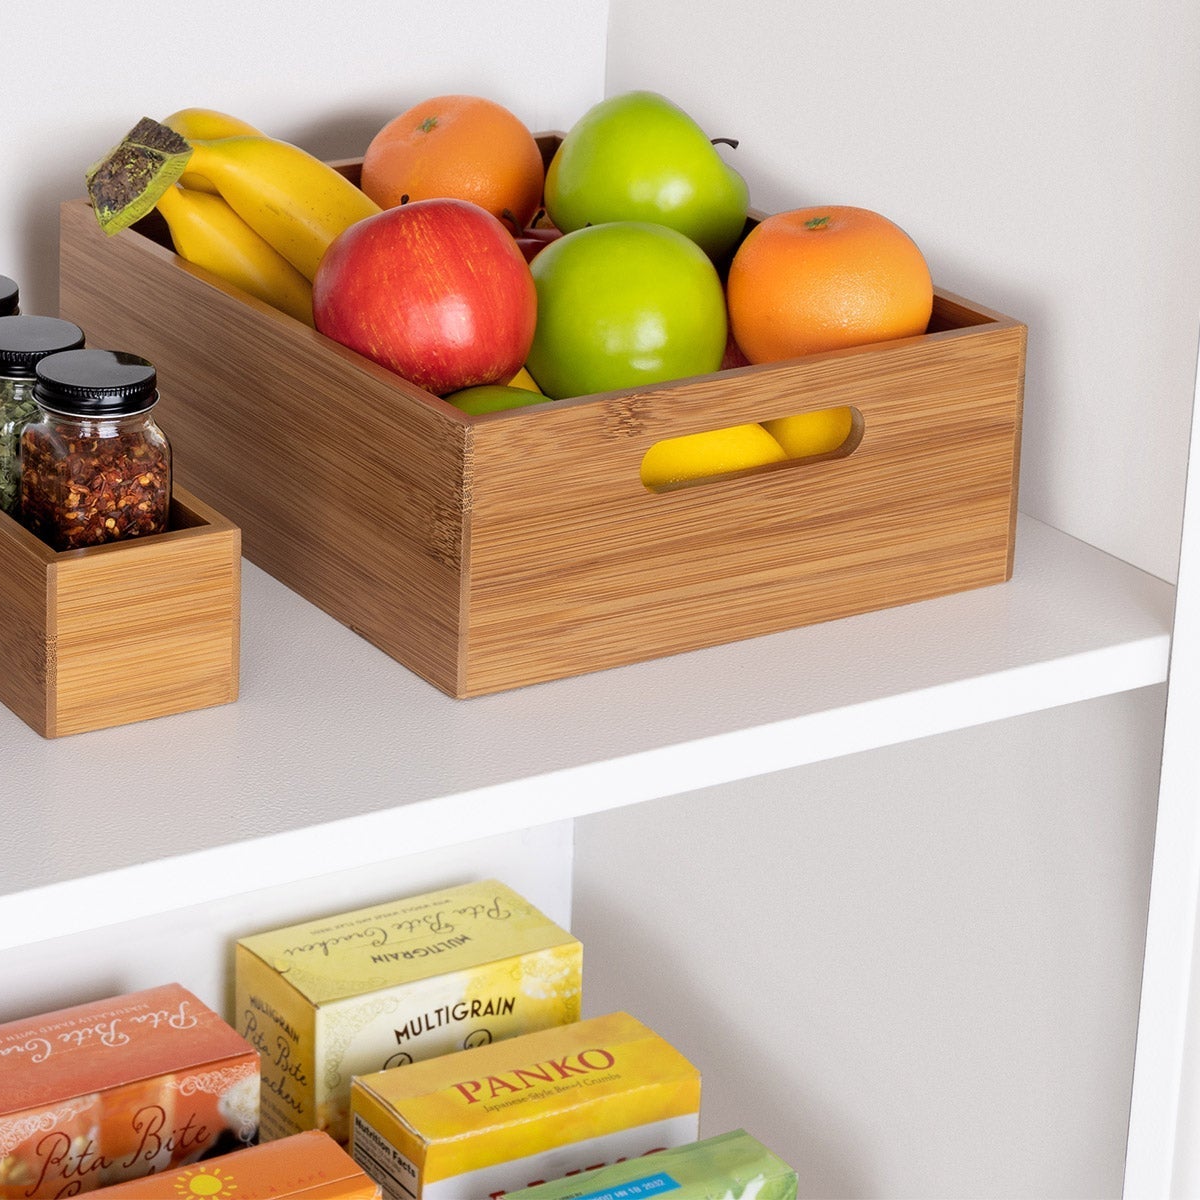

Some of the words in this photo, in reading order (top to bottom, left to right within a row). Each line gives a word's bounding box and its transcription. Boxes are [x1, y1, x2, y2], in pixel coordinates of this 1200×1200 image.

[391, 911, 455, 934] Bite
[452, 897, 512, 922] Pita
[282, 926, 389, 957] Crackers
[371, 934, 473, 964] MULTIGRAIN
[131, 1001, 199, 1030] Pita
[393, 996, 516, 1045] MULTIGRAIN
[56, 1018, 130, 1048] Bite
[451, 1048, 615, 1104] PANKO
[123, 1105, 212, 1169] Bite
[355, 1116, 391, 1156] Nutrition
[392, 1150, 416, 1178] Facts
[25, 1131, 114, 1199] Pita
